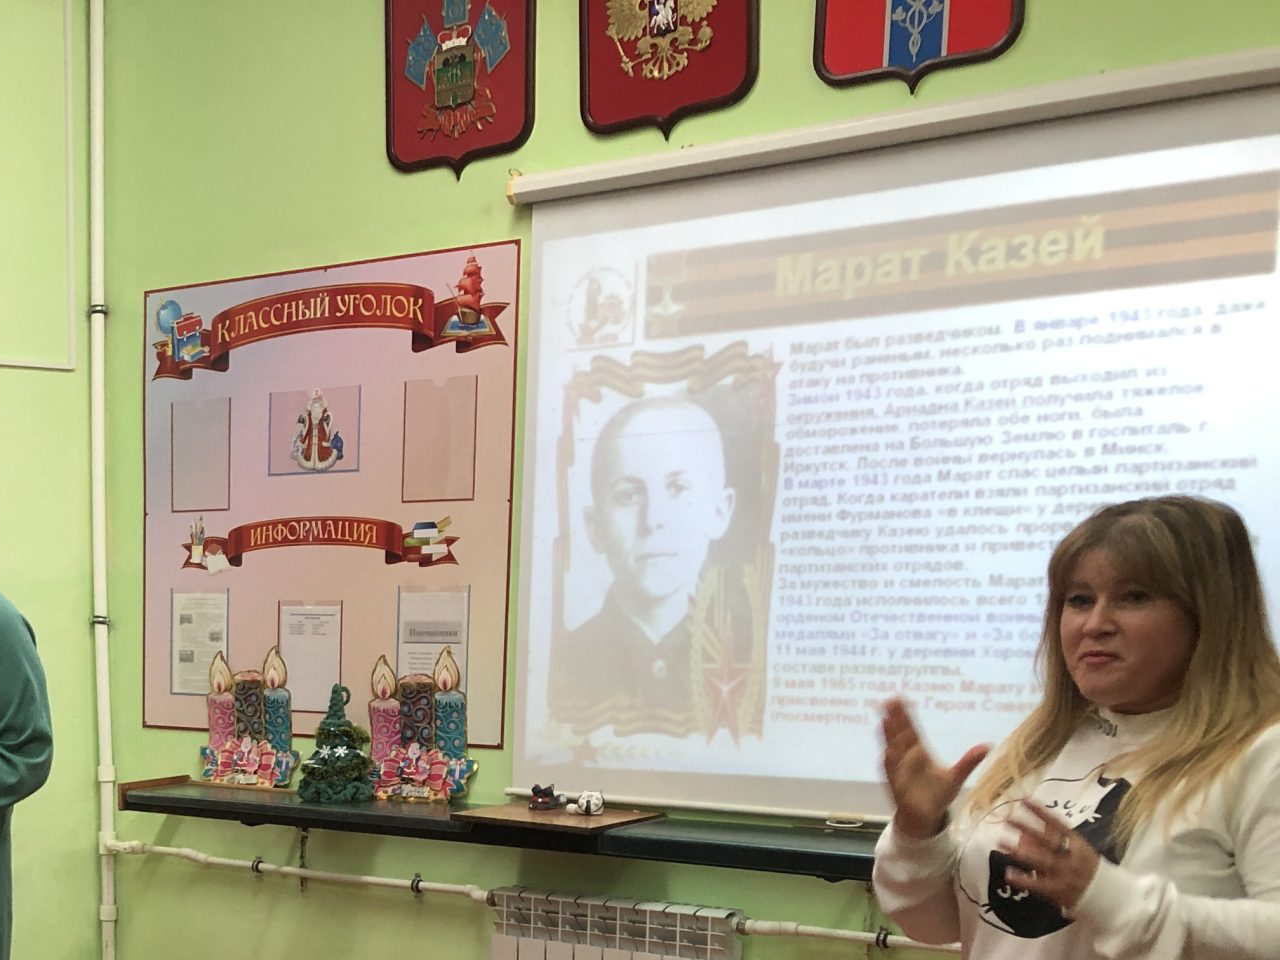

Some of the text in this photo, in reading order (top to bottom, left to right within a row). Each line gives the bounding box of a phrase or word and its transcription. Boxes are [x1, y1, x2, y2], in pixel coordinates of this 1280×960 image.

[773, 213, 1108, 299] Марат Казей
[216, 291, 424, 343] КЛАССНЫЙ УГОЛОК
[790, 340, 840, 356] Марат
[844, 337, 880, 350] был
[789, 356, 847, 374] будучи
[939, 339, 1037, 358] несколько
[934, 380, 985, 396] когда
[990, 374, 1043, 392] отряд
[883, 401, 960, 418] Ариадна
[908, 415, 992, 432] потеряла
[996, 411, 1032, 426] обе
[1091, 404, 1144, 420] была
[784, 441, 880, 458] доставлена
[885, 439, 905, 452] на
[909, 436, 994, 452] Большую
[1001, 430, 1066, 446] Землю
[857, 455, 909, 470] После
[977, 448, 1077, 466] вернулась
[783, 476, 795, 491] В
[798, 477, 847, 492] марте
[853, 472, 889, 488] 1943
[893, 473, 933, 487] года
[936, 468, 992, 485] Марат
[997, 467, 1040, 481] спас
[837, 492, 885, 507] Когда
[889, 489, 972, 505] каратели
[974, 486, 1029, 500] взяли
[781, 510, 832, 524] имени
[836, 508, 933, 525] Фурманова
[250, 523, 378, 547] ИНФОРМАЦИЯ
[780, 526, 873, 544] разведчику
[877, 523, 931, 539] Казею
[935, 521, 1009, 539] удалось
[859, 542, 960, 557] противника
[779, 561, 889, 576] партизанских
[778, 577, 797, 590] За
[799, 578, 879, 592] мужество
[883, 579, 895, 589] и
[900, 577, 982, 588] смелость
[815, 595, 852, 608] года
[856, 595, 970, 607] исполнилось
[775, 613, 845, 625] орденом
[850, 610, 980, 624] Отечественной
[775, 629, 856, 642] медалями
[965, 631, 977, 641] и
[776, 643, 791, 656] 11
[795, 646, 826, 656] мая
[832, 644, 866, 657] 1944
[901, 646, 976, 661] деревни
[773, 662, 836, 674] составе
[784, 679, 815, 689] мая
[821, 677, 857, 690] 1965
[860, 680, 897, 693] года
